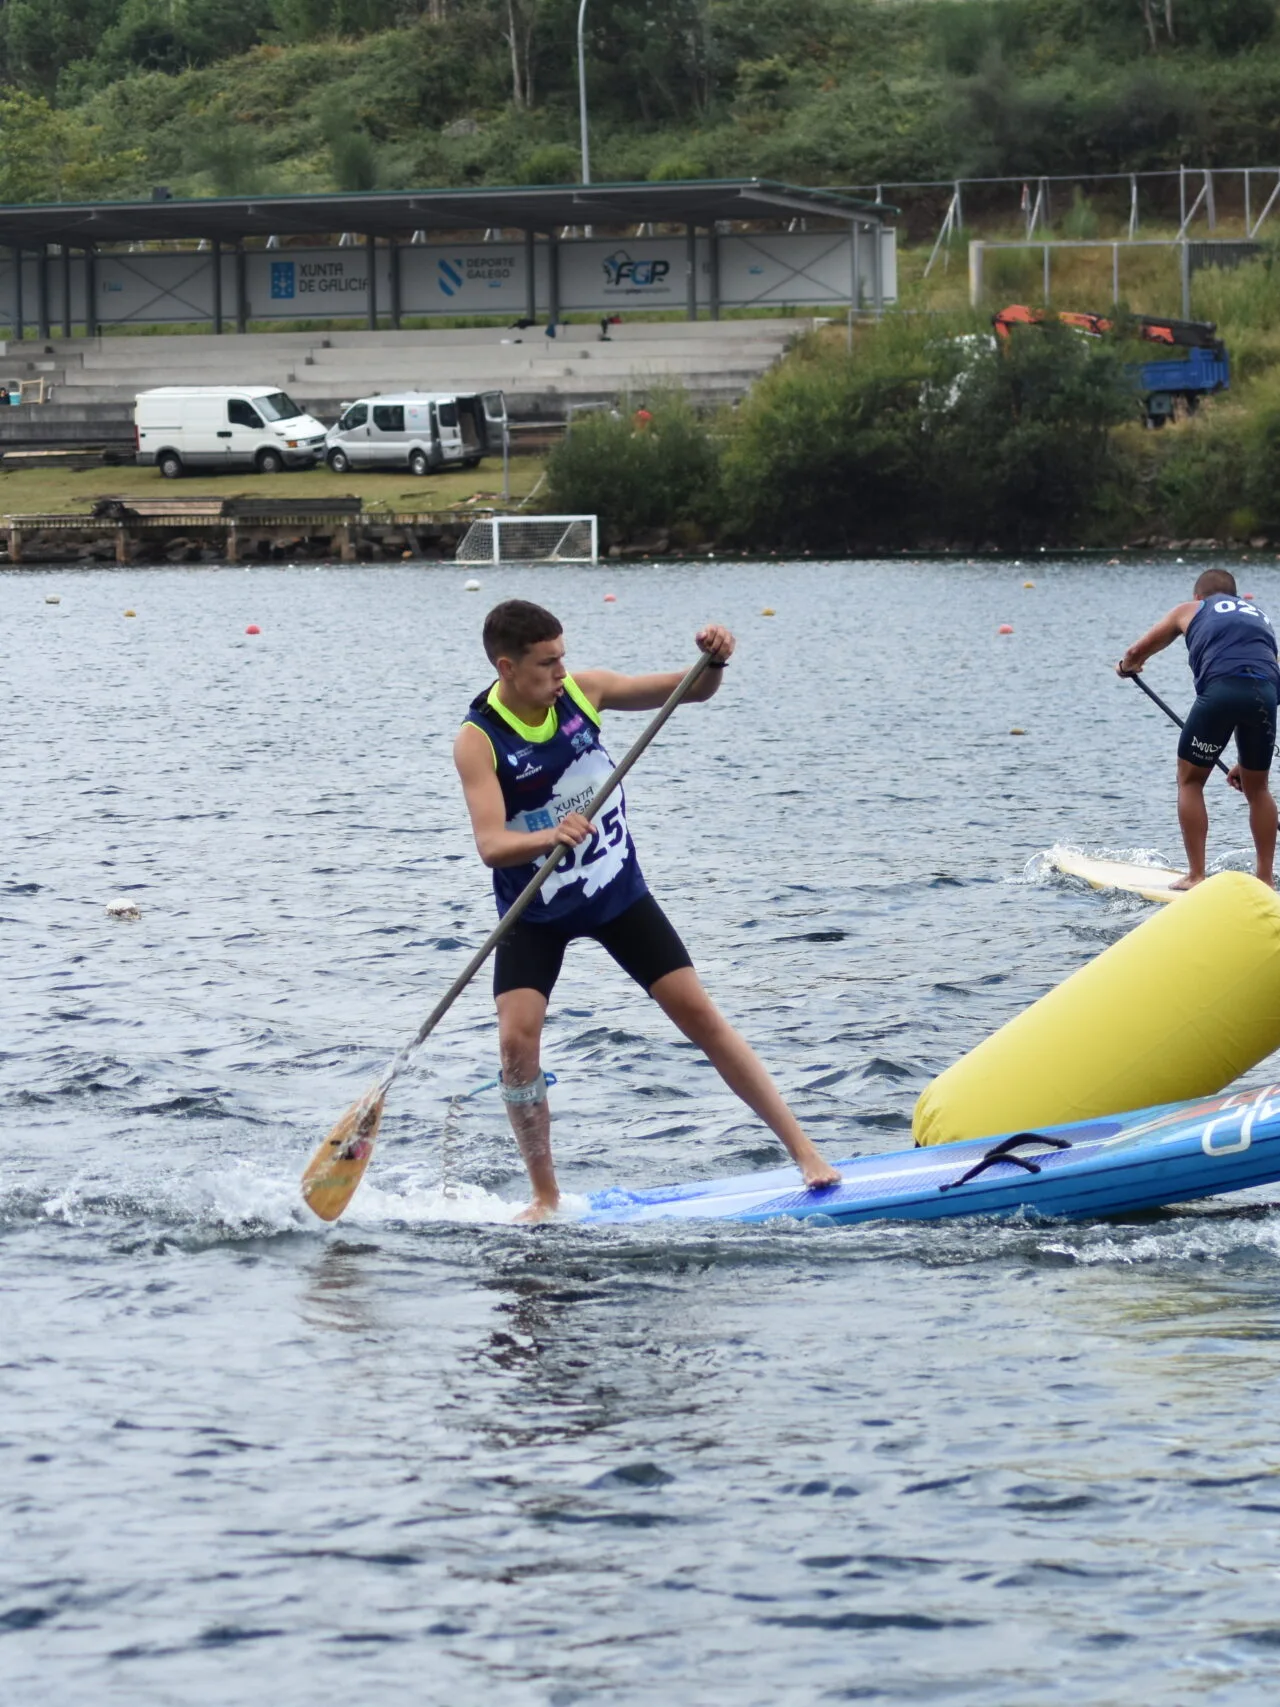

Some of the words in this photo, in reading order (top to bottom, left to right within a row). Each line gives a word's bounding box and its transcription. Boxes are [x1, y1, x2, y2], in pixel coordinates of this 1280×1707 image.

[466, 257, 515, 268] DEPORTE
[300, 262, 344, 277] XUNTA
[466, 268, 511, 279] GALEGO
[299, 279, 315, 292] DE
[553, 785, 595, 815] XUNTA
